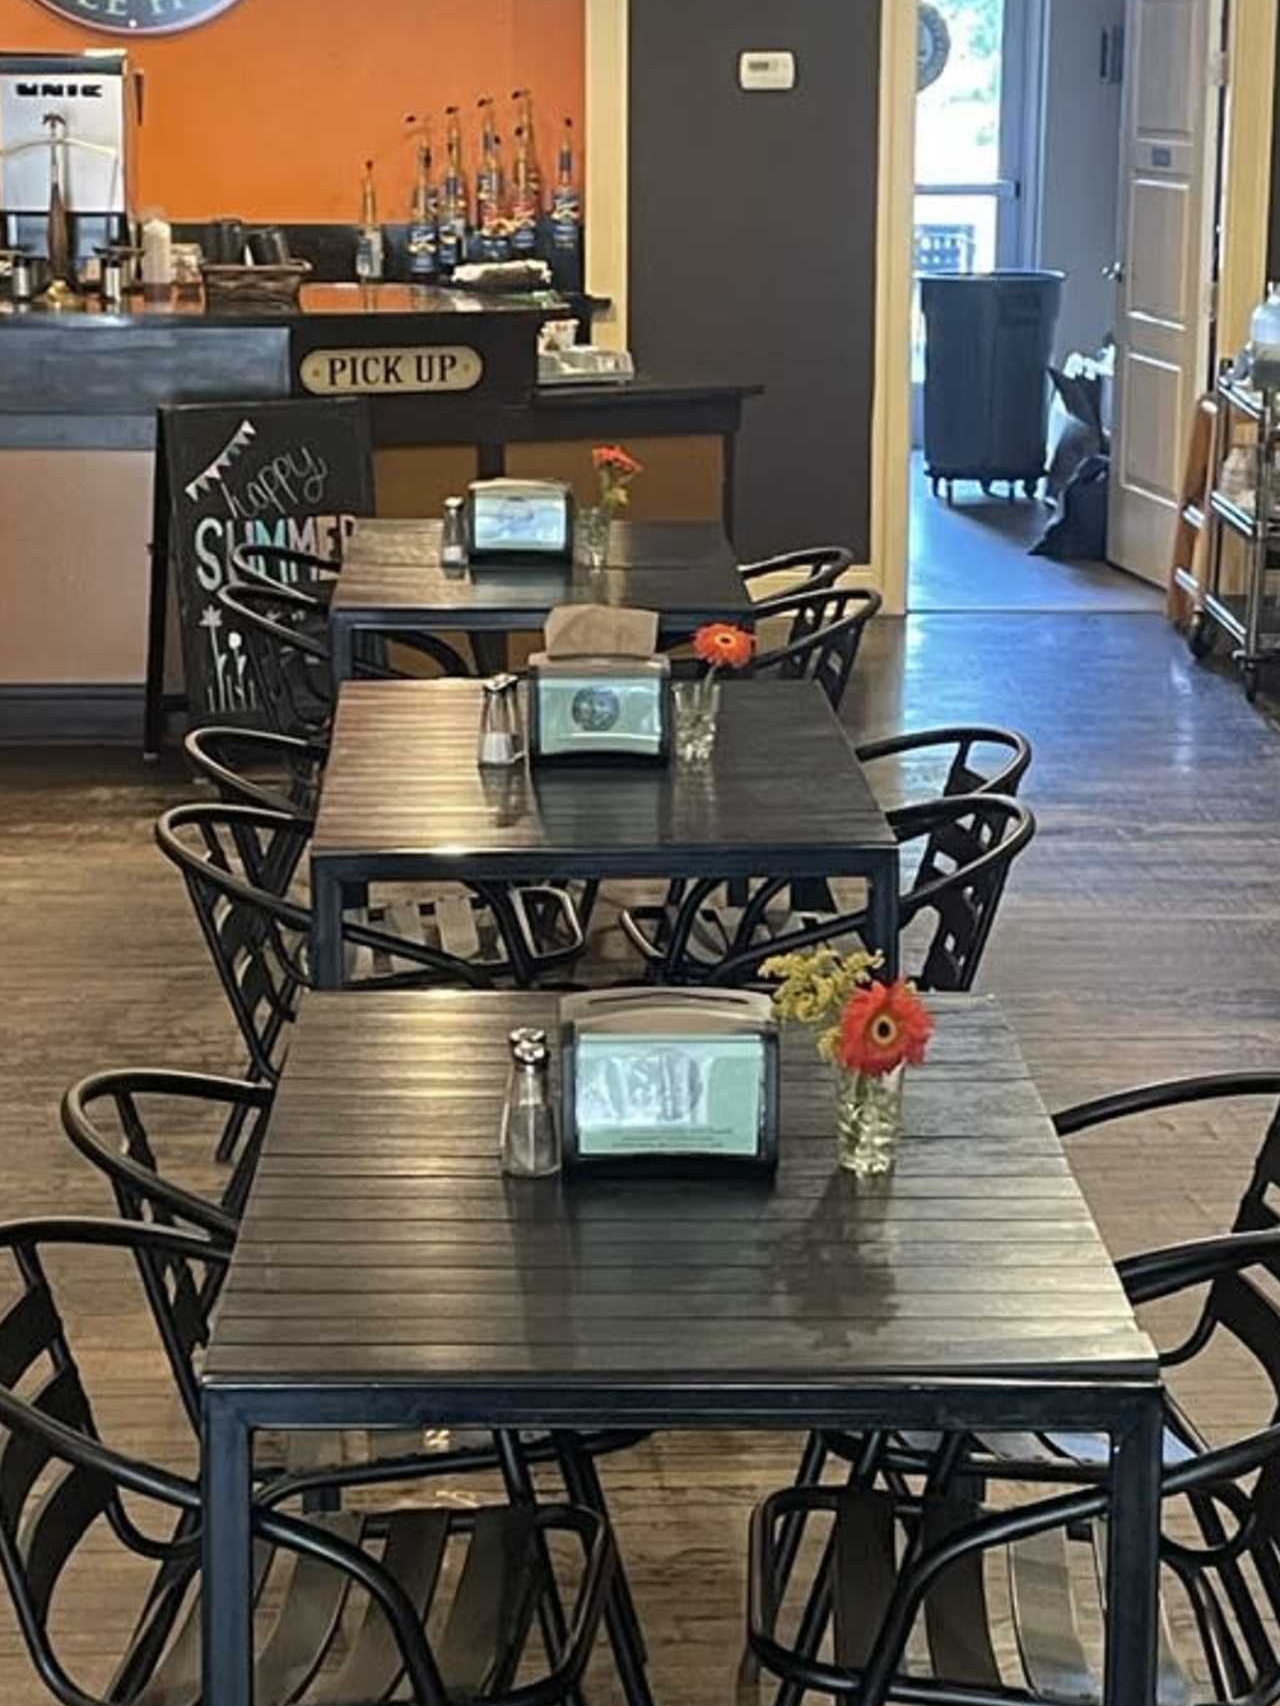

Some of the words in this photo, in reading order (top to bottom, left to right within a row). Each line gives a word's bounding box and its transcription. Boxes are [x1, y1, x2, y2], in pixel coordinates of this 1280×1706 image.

[328, 355, 404, 386] PICK
[414, 354, 458, 384] UP
[219, 446, 329, 520] happy
